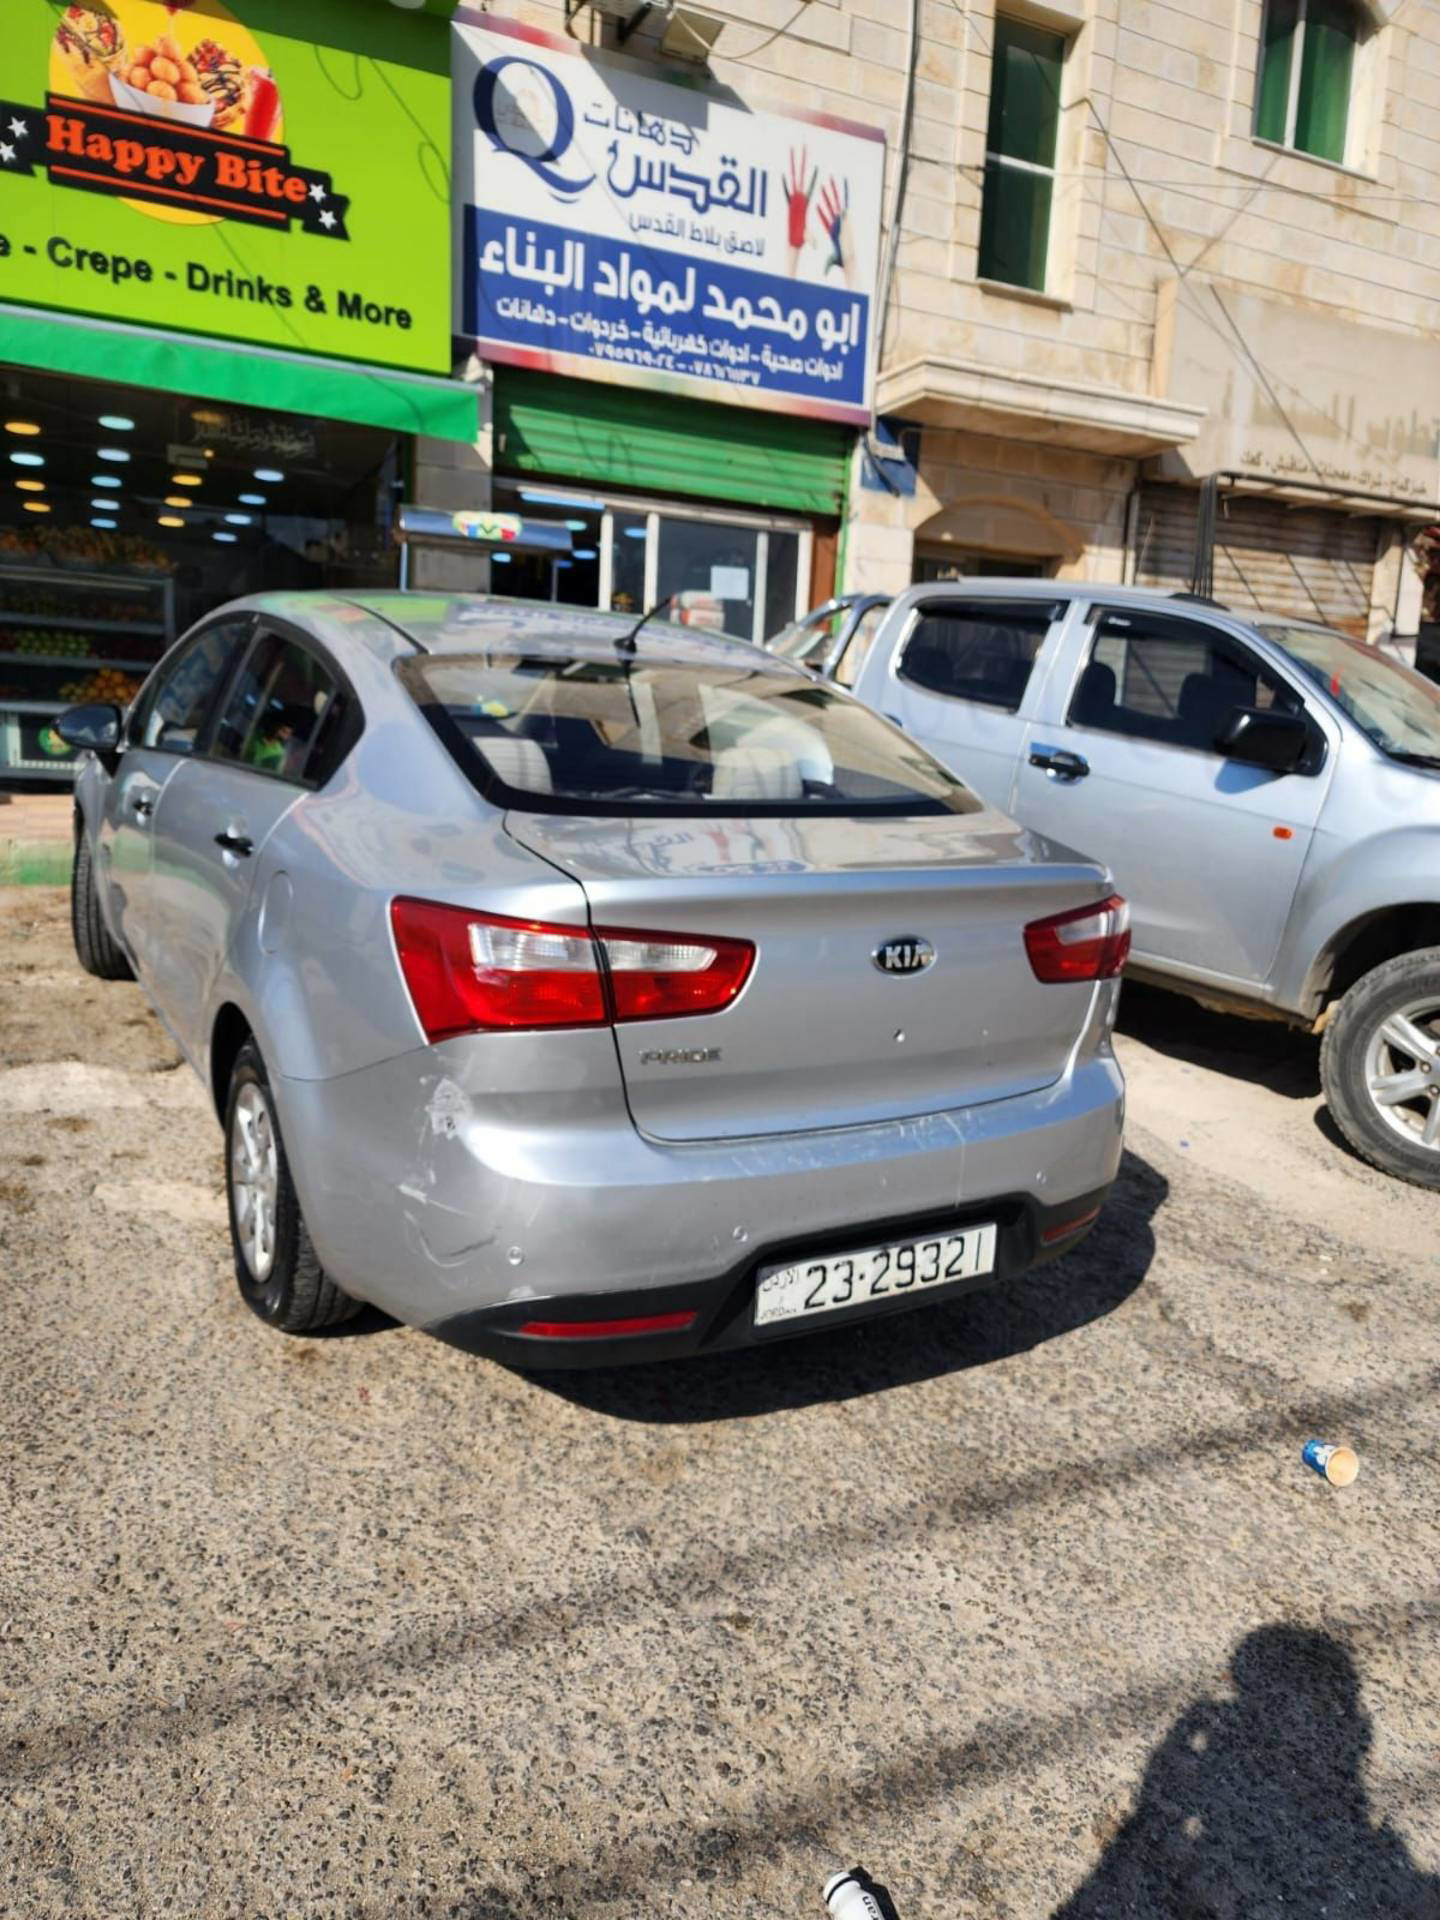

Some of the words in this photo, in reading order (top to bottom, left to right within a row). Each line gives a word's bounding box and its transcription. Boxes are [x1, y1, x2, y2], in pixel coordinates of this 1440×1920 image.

[45, 114, 204, 185] Happy
[215, 151, 308, 202] Bite
[607, 140, 767, 217] القدس
[629, 212, 685, 238] القدس
[47, 237, 153, 283] Crepe
[187, 263, 292, 308] Drinks
[303, 285, 327, 313] &
[338, 290, 412, 330] More
[479, 226, 585, 297] البناء
[593, 251, 696, 318] لمواد
[496, 297, 556, 326] دهانات
[703, 284, 807, 341] محمد
[815, 303, 861, 355] ابو
[885, 943, 933, 969] KIA
